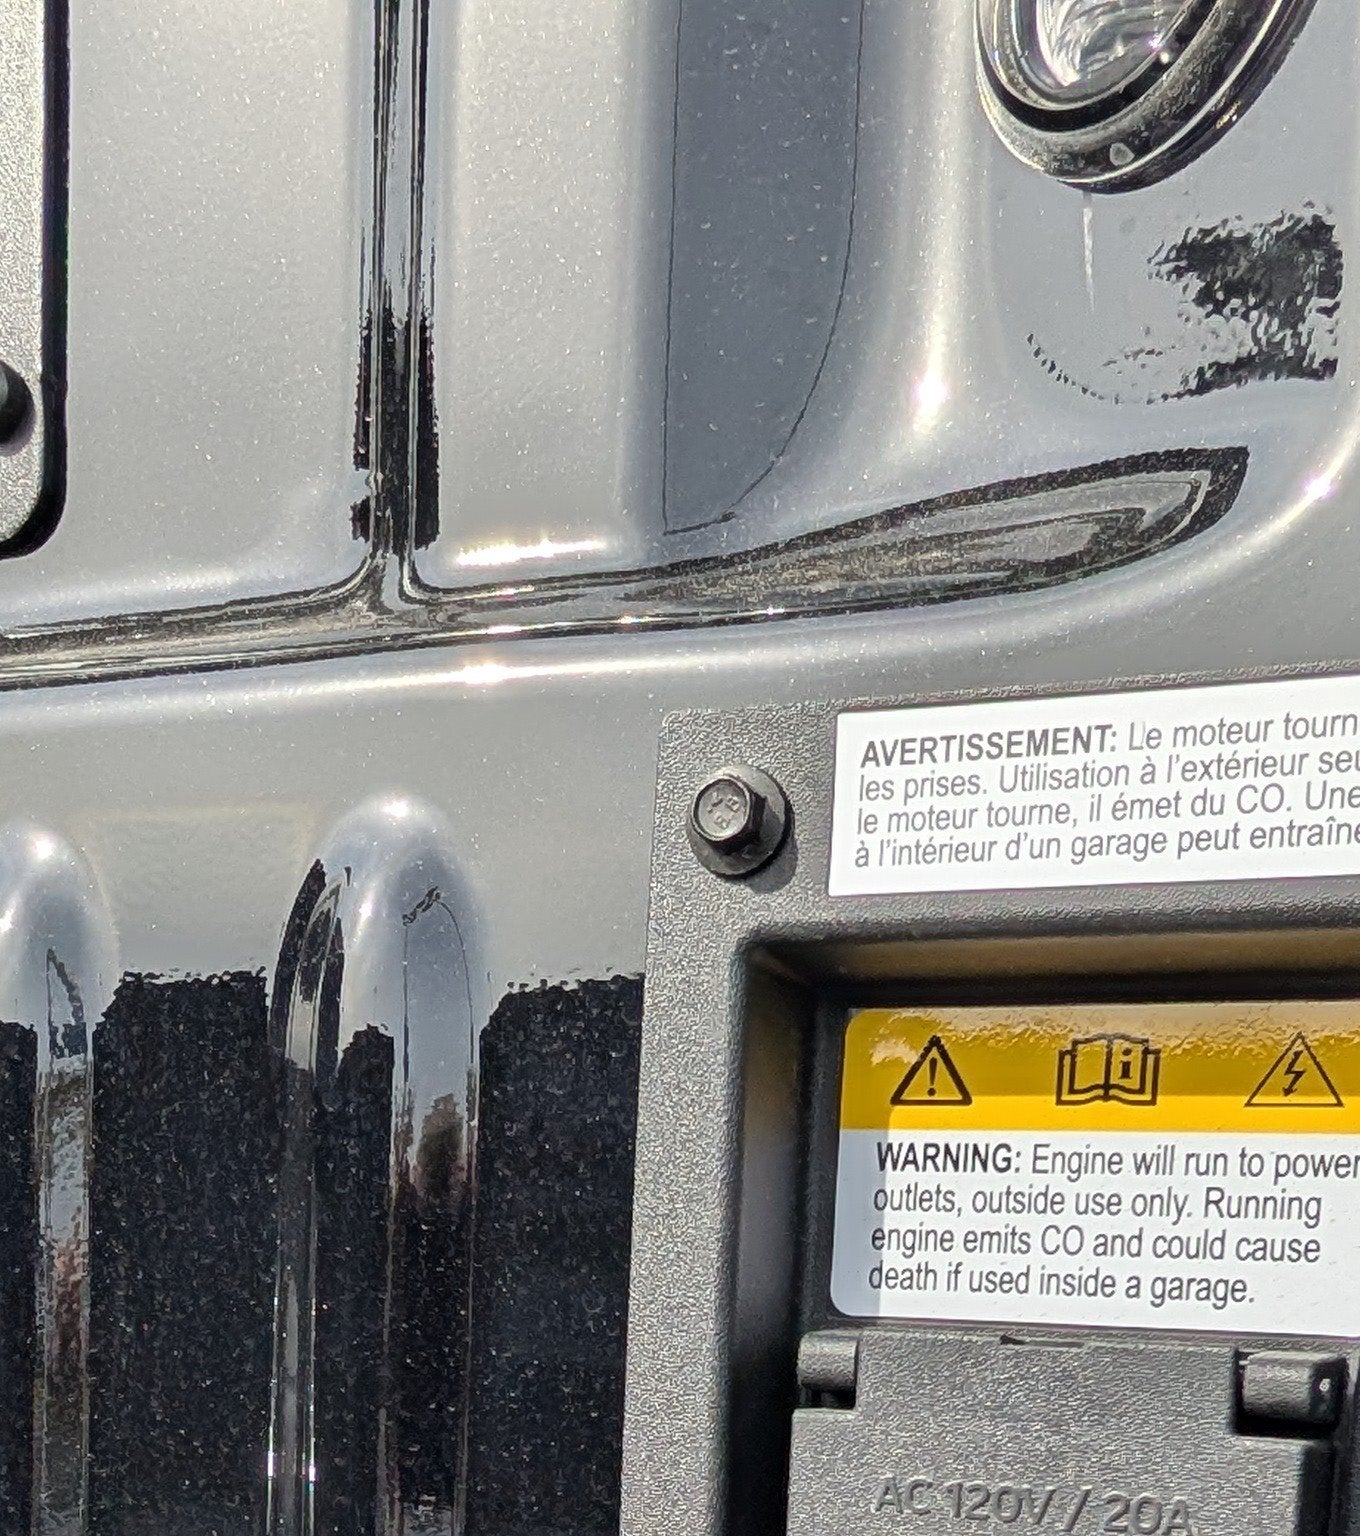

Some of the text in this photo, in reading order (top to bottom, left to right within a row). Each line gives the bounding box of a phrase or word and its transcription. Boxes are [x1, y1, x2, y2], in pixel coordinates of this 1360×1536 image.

[860, 723, 1117, 769] AVERTISSEMENT:
[1128, 721, 1163, 751] Le
[1172, 717, 1275, 748] moteur
[859, 774, 895, 802] les
[903, 769, 987, 807] prises.
[999, 759, 1130, 794] Utilisation
[1139, 755, 1157, 785] à
[857, 807, 879, 835] le
[887, 804, 979, 834] moteur
[986, 801, 1078, 829] tourne,
[1089, 793, 1102, 823] il
[1110, 790, 1183, 822] émet
[1190, 786, 1226, 818] du
[1236, 782, 1292, 815] CO.
[854, 840, 870, 868] à
[1070, 831, 1169, 866] garage
[1177, 821, 1241, 860] peut
[876, 1141, 1022, 1174] WARNING:
[1031, 1142, 1124, 1184] Engine
[1132, 1143, 1177, 1176] will
[1183, 1152, 1229, 1178] run
[1238, 1146, 1265, 1178] to
[872, 1181, 1323, 1230] outlets, outside use only. Running
[870, 1221, 1321, 1264] engine emits CO and could cause
[868, 1259, 1255, 1311] death if used inside a garage.
[874, 1476, 934, 1515] AC
